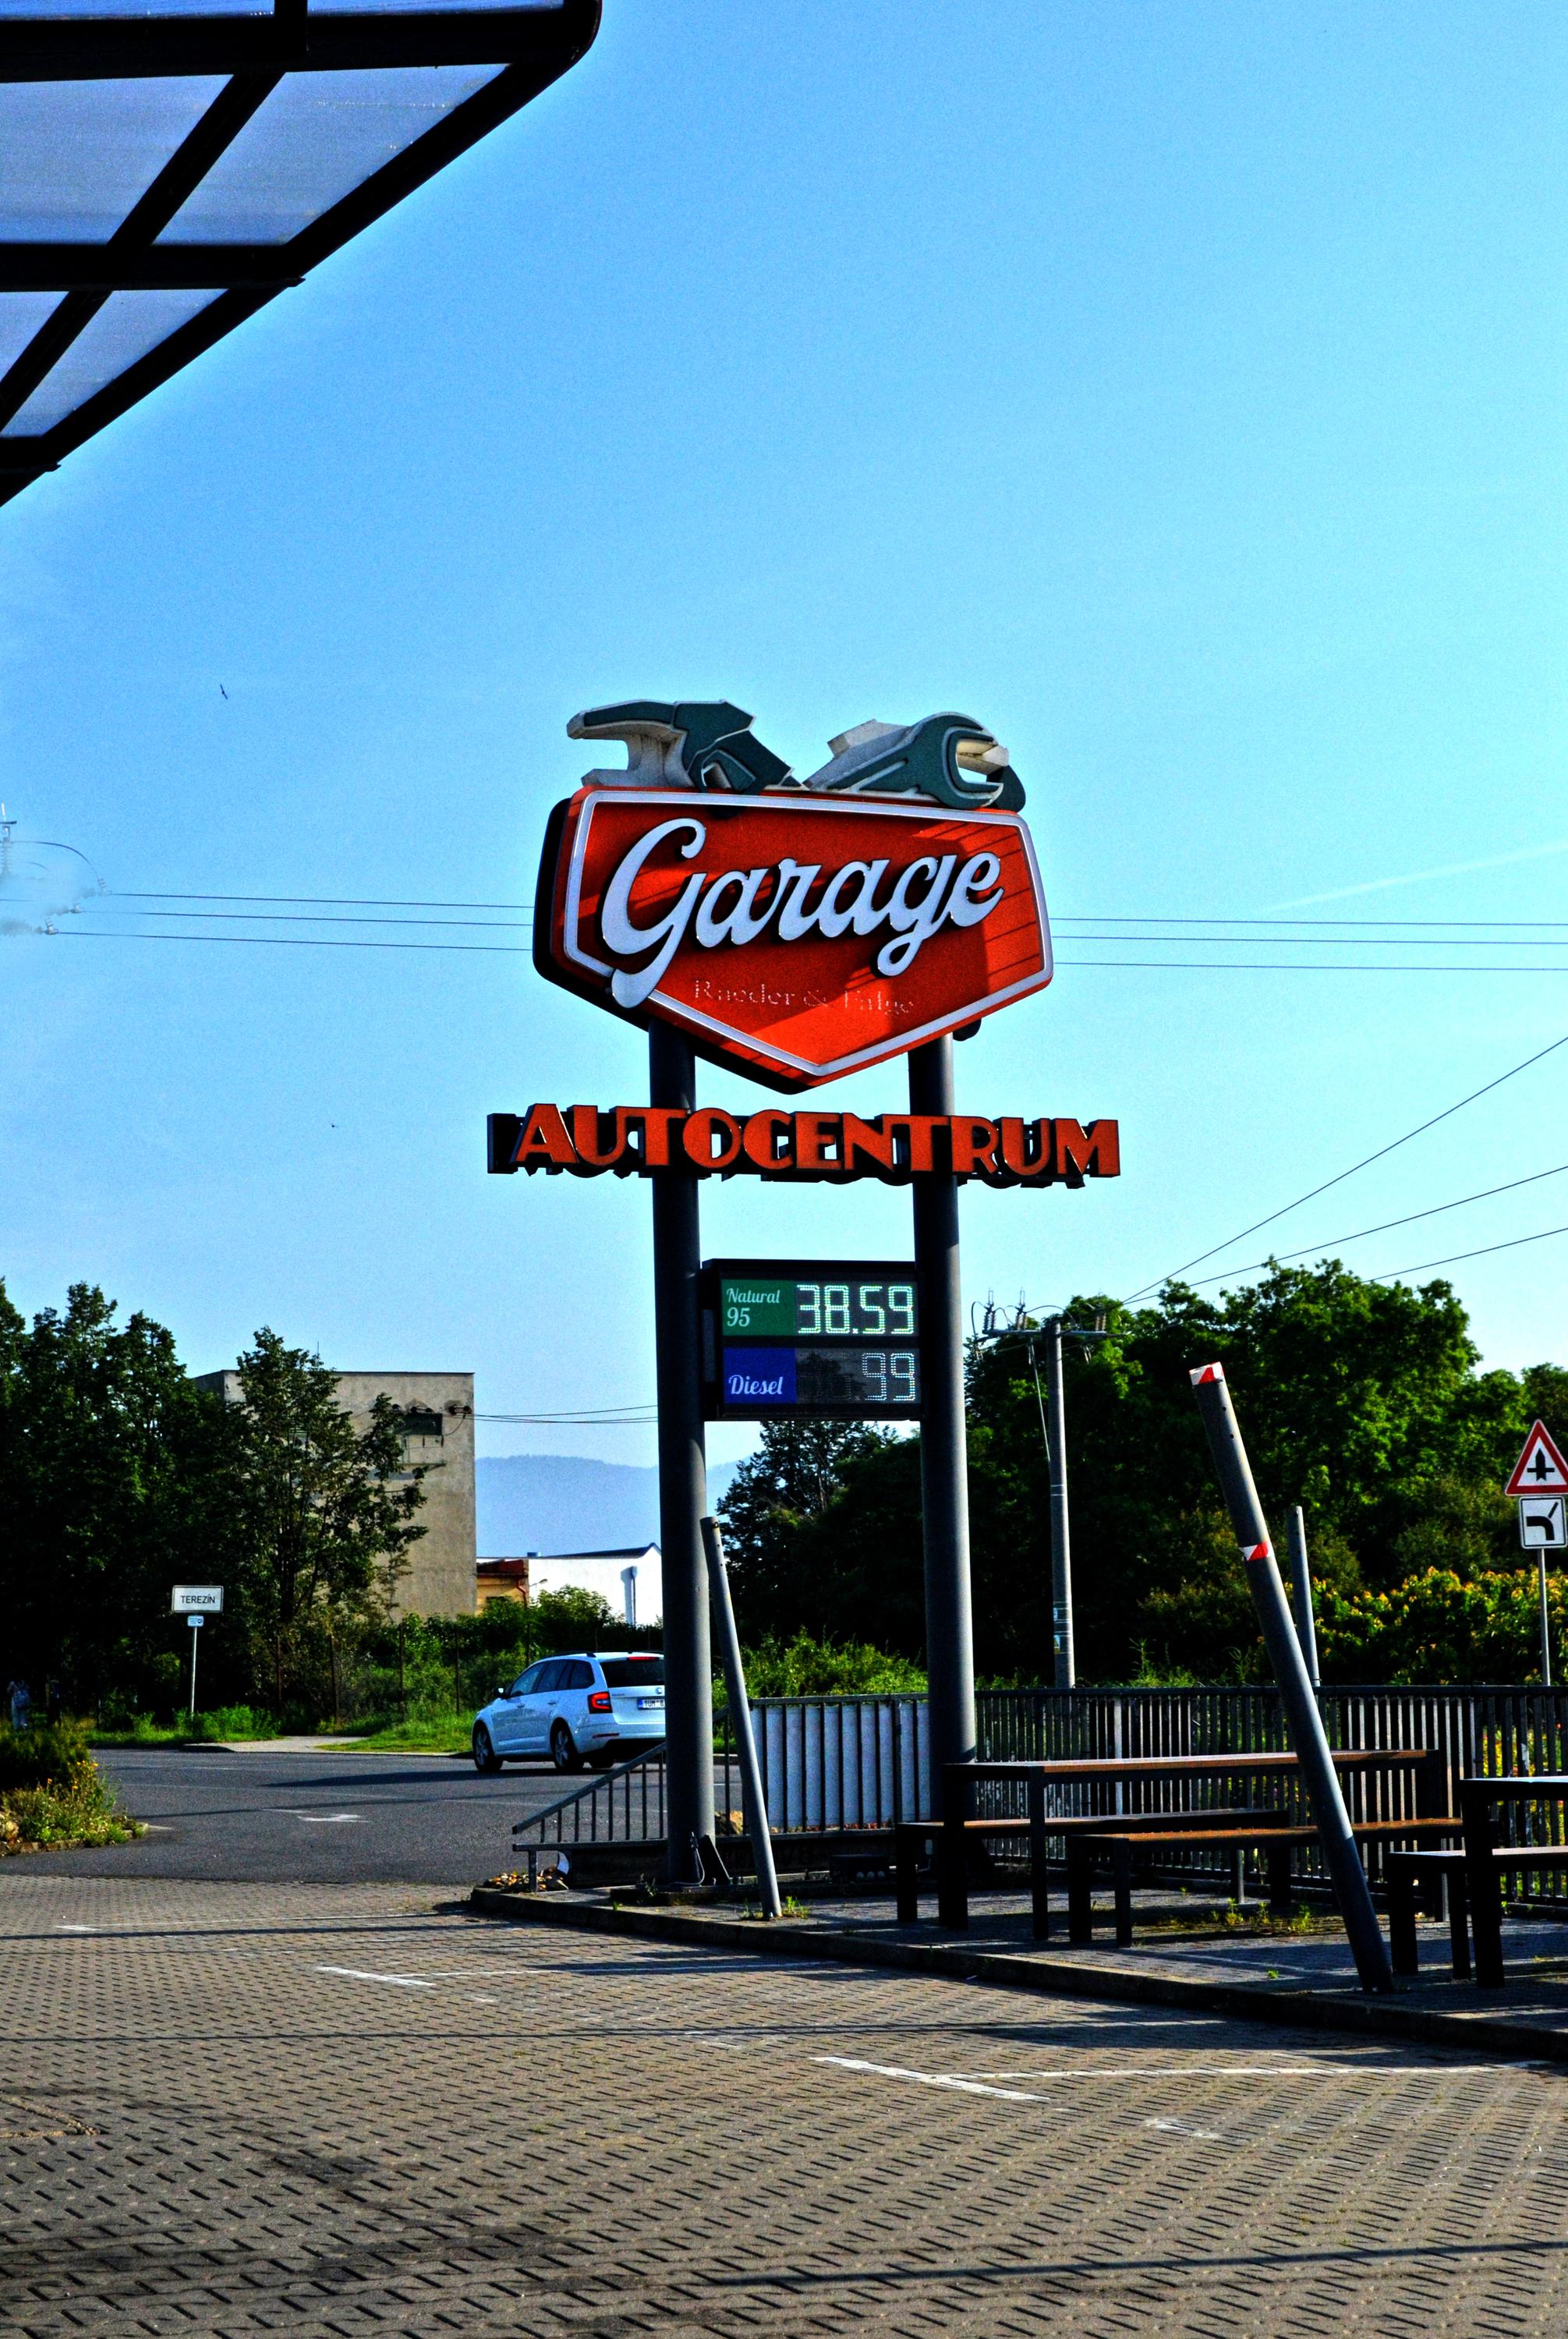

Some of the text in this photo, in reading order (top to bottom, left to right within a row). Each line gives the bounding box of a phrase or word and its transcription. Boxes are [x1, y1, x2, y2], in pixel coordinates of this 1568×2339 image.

[601, 818, 1004, 1008] Garage
[804, 989, 828, 1007] &
[510, 1103, 1121, 1177] AUTOCENTRUM
[726, 1287, 780, 1304] Natural
[726, 1307, 751, 1327] 95
[797, 1284, 915, 1335] 38.59
[728, 1374, 783, 1395] Diesel
[180, 1594, 216, 1604] TEREZÍN
